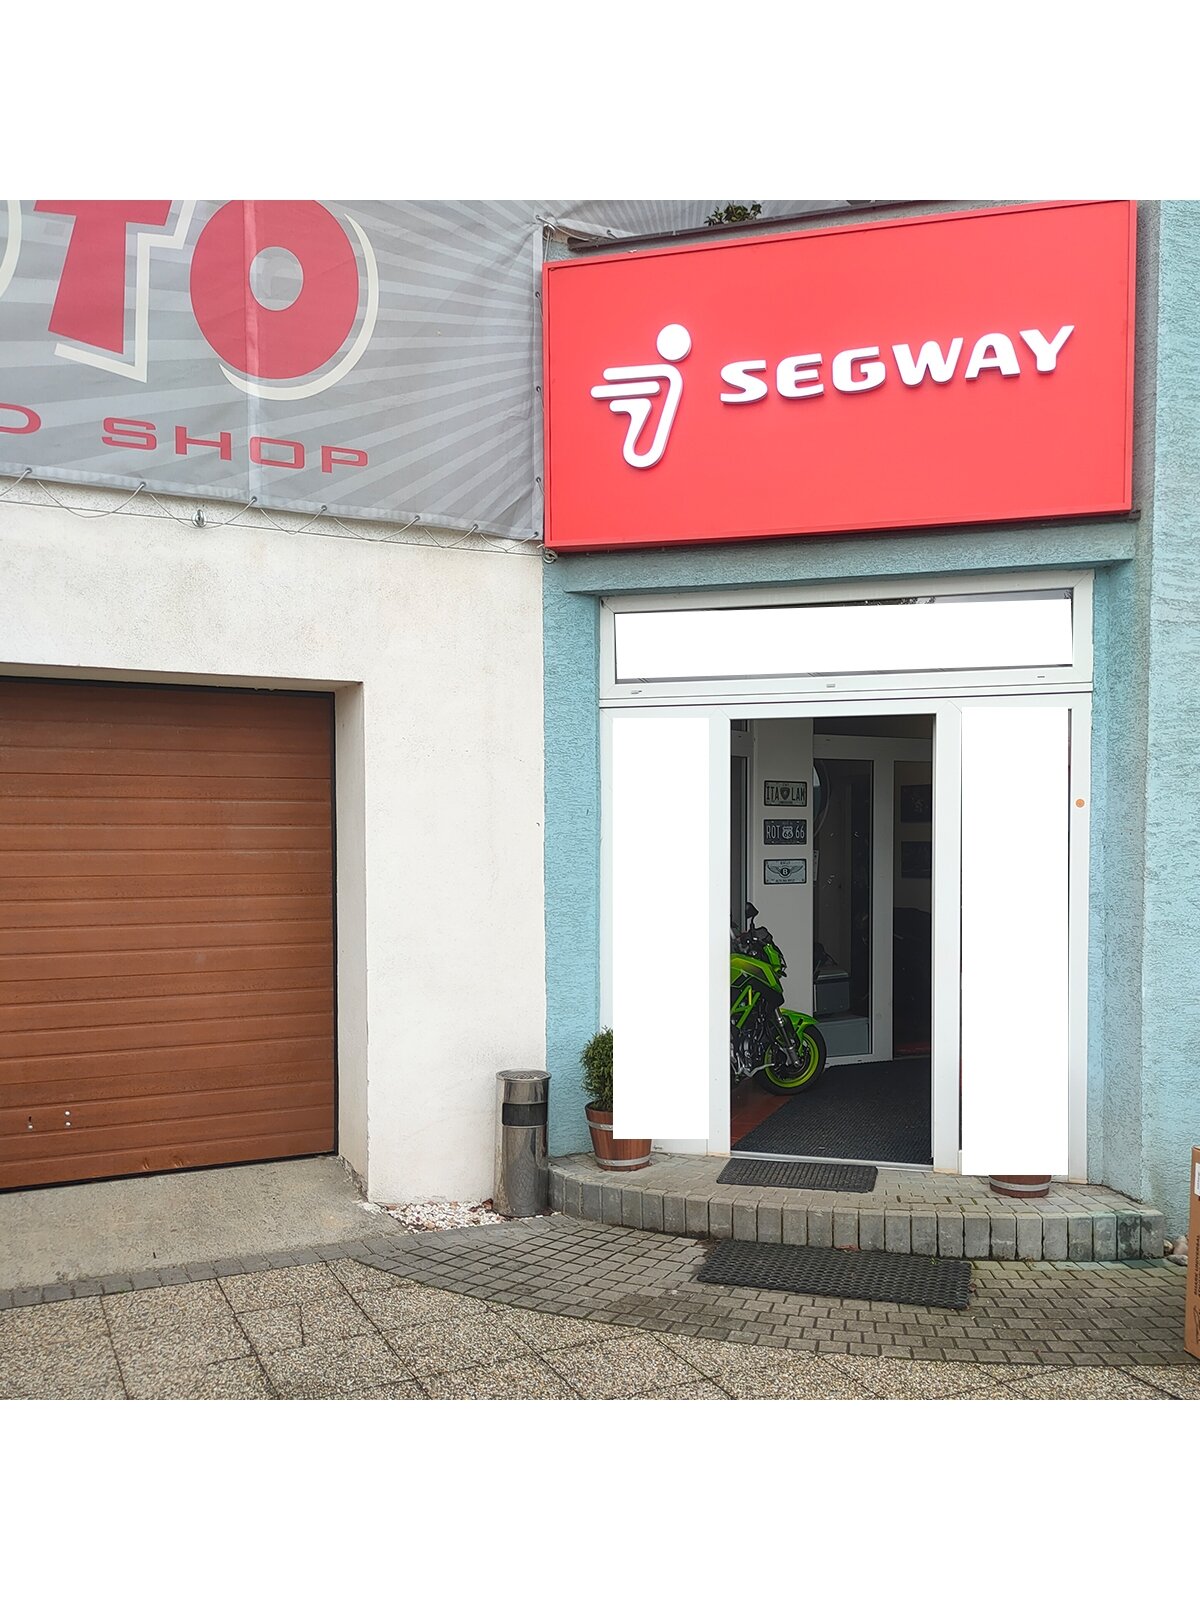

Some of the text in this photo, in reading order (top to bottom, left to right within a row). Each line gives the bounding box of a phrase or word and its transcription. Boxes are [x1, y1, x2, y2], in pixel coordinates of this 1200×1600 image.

[0, 200, 378, 400] TO
[720, 325, 1075, 405] SEGWAY
[101, 416, 369, 474] SHOP
[795, 825, 805, 839] 66
